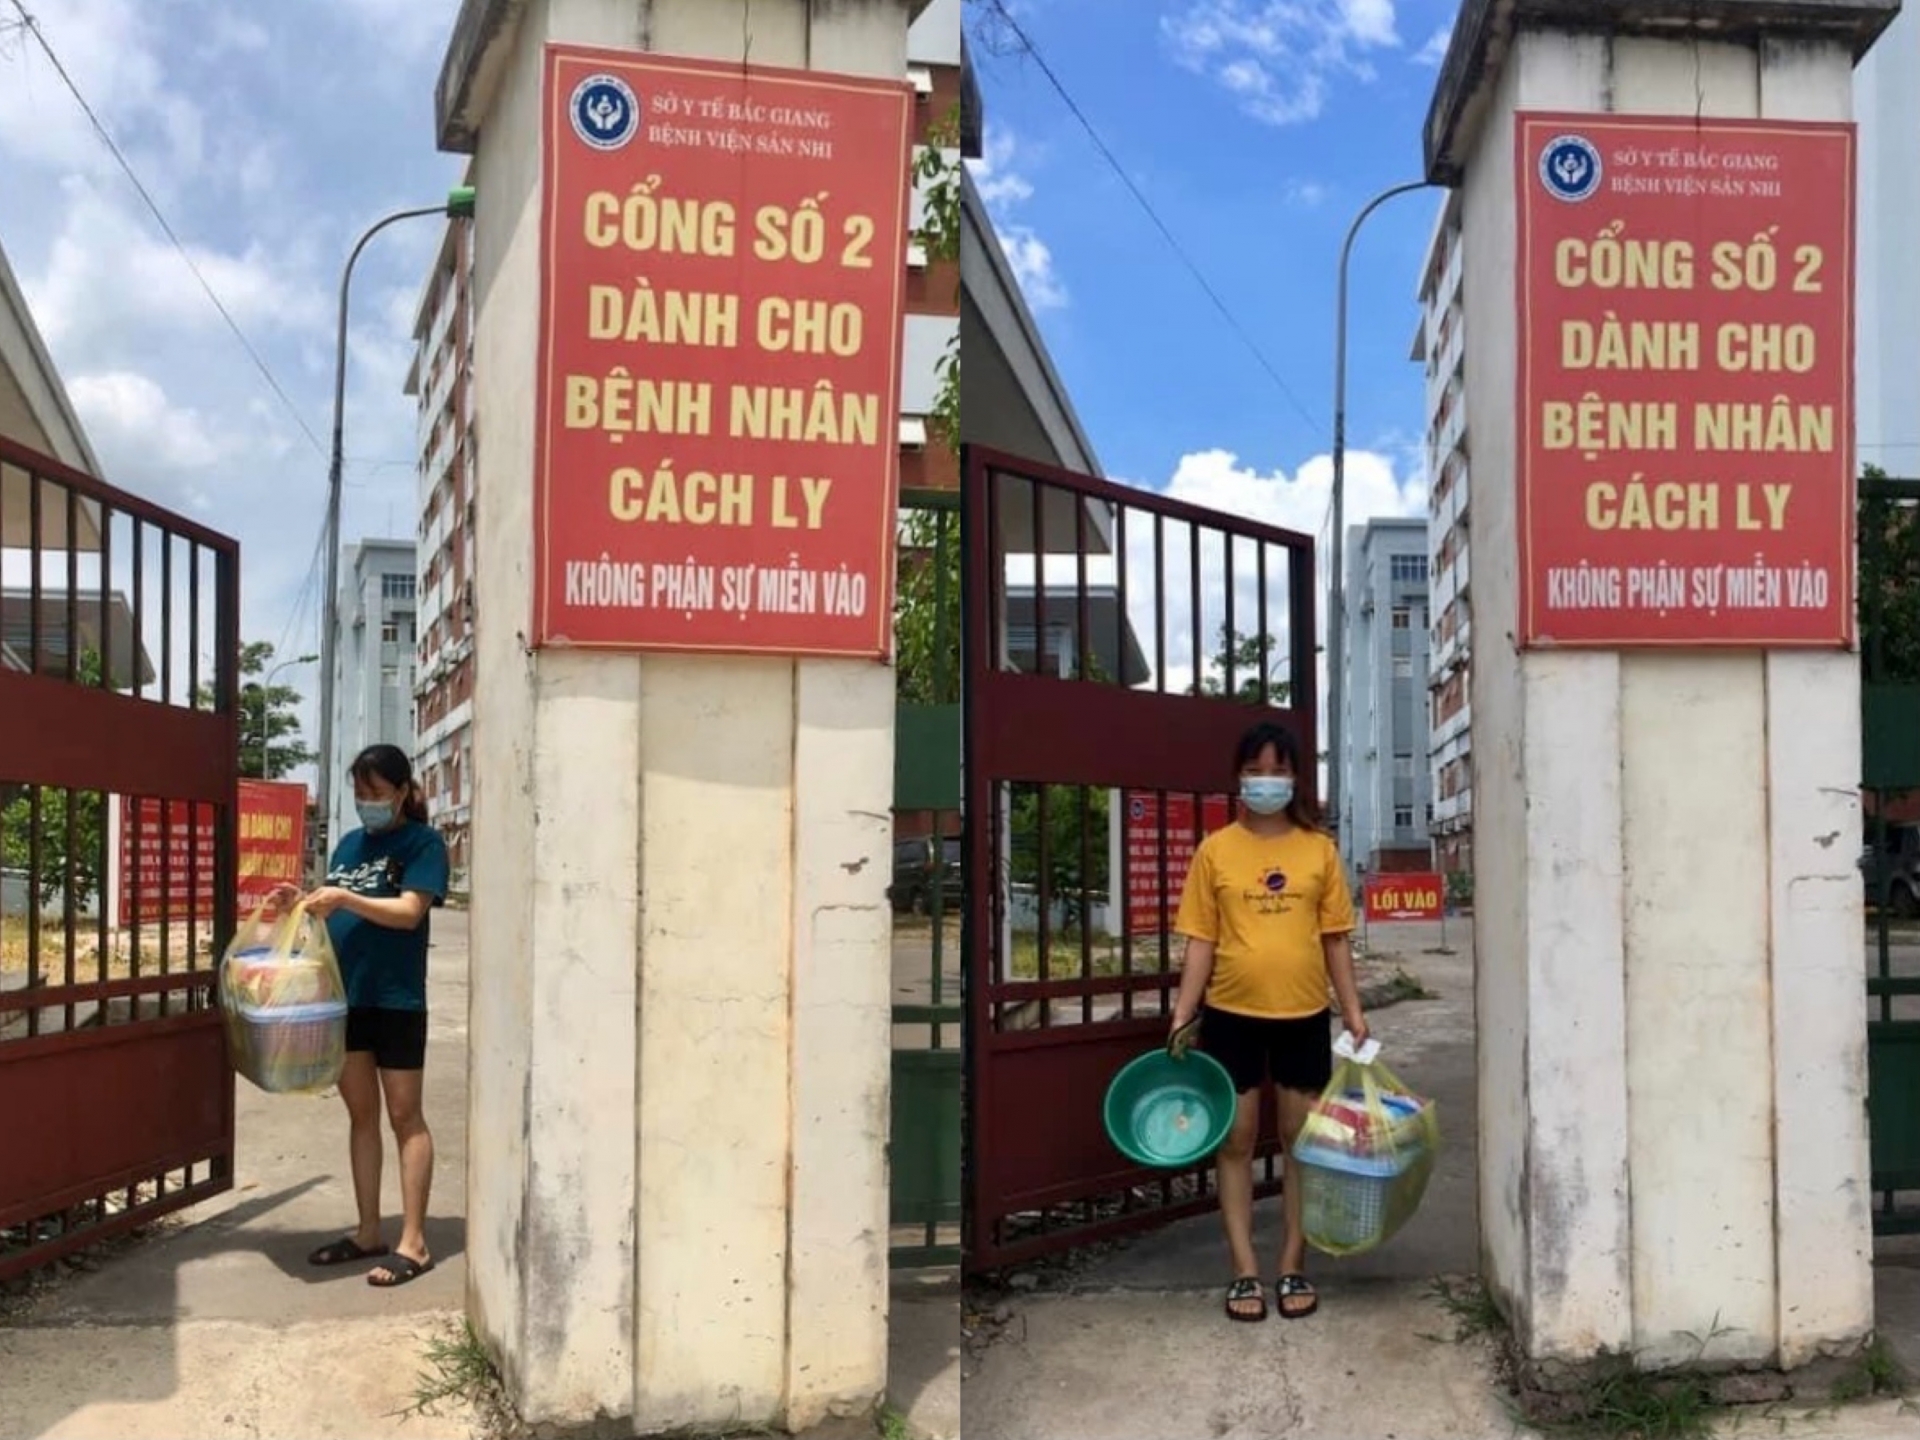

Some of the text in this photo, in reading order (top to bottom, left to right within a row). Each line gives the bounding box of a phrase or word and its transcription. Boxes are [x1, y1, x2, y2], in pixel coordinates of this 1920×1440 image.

[649, 122, 700, 148] BỆNH
[706, 128, 751, 154] VIỆN
[798, 138, 832, 160] NHI
[683, 97, 695, 116] Y
[770, 106, 830, 129] GIANG
[1611, 174, 1661, 196] BỆNH
[1664, 175, 1707, 196] VIỆN
[1750, 180, 1781, 197] NHI
[1639, 150, 1651, 167] Y
[1722, 152, 1779, 171] GIANG
[584, 173, 874, 268] CỔNG SỐ 2
[1555, 219, 1824, 293] CỔNG SỐ 2
[588, 276, 863, 356] DÀNH CHO
[1561, 311, 1816, 373] DÀNH CHO
[564, 365, 879, 446] BỆNH NHÂN
[1542, 391, 1833, 461] BỆNH NHÂN
[608, 458, 832, 529] CÁCH LY
[1585, 472, 1793, 531] CÁCH LY
[565, 551, 867, 620] KHÔNG PHẬN SỰ MIỄN VÀO
[1548, 552, 1829, 617] KHÔNG PHẬN SỰ MIỄN VÀO
[1371, 887, 1438, 911] LỐI VÀO
